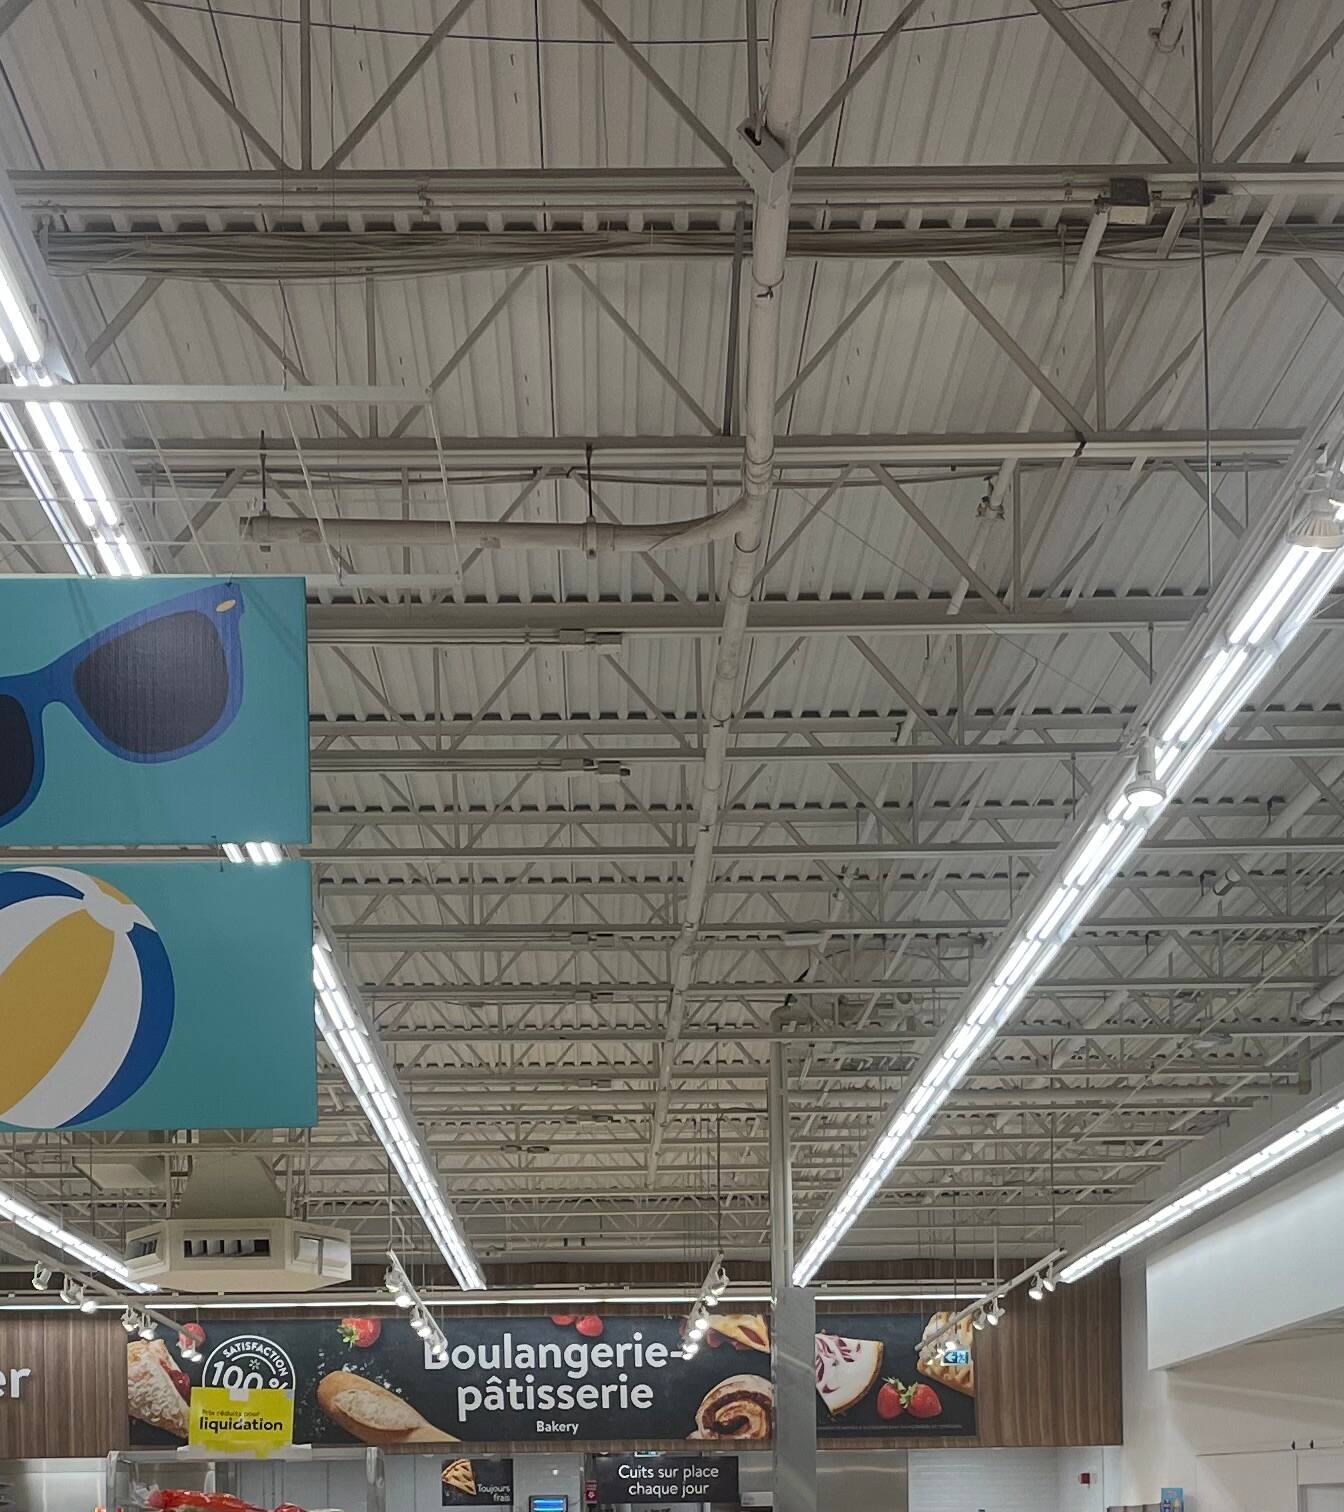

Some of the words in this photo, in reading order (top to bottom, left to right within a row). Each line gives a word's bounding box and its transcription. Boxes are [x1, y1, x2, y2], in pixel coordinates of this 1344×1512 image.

[223, 1341, 289, 1377] SATISFACTION
[457, 1374, 654, 1422] pâtisserie
[199, 1416, 283, 1434] liquidation
[536, 1420, 579, 1435] Bakery
[618, 1464, 654, 1479] Cuits
[658, 1466, 679, 1479] sur
[683, 1464, 719, 1481] place
[477, 1483, 511, 1495] Toujours
[493, 1493, 511, 1502] frais
[628, 1481, 678, 1498] chaque
[681, 1481, 710, 1498] jour
